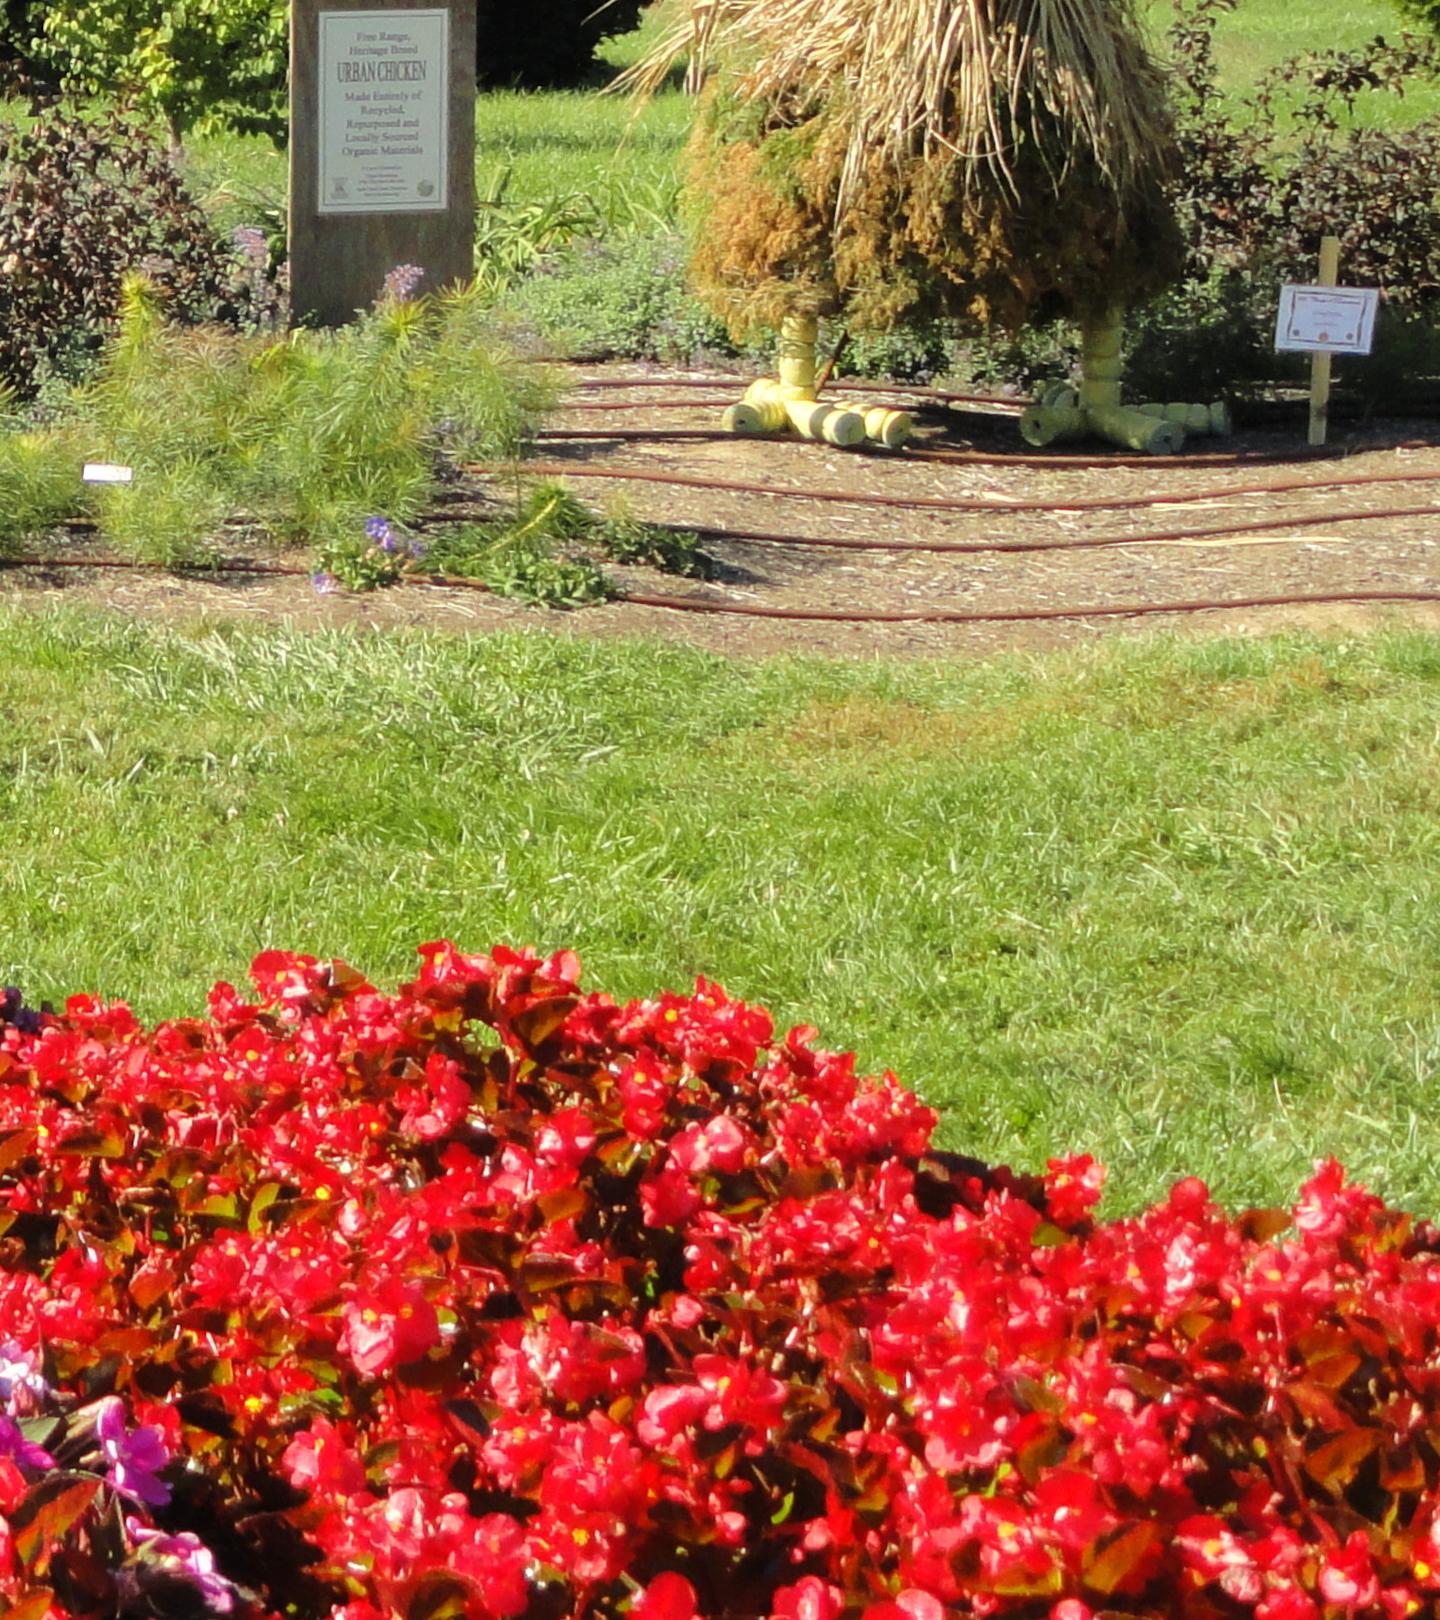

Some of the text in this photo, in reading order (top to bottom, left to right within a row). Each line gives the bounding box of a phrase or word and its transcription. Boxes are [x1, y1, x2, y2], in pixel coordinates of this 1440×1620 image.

[356, 32, 377, 41] Free
[349, 45, 419, 56] Heritage Breed
[337, 60, 427, 83] URBAN CHICKEN
[345, 90, 423, 103] Made Entirely of
[361, 105, 405, 116] Recycled,
[347, 118, 419, 130] Repurposed and
[345, 131, 419, 143] Locally Sourced
[342, 146, 424, 157] Organic Materials
